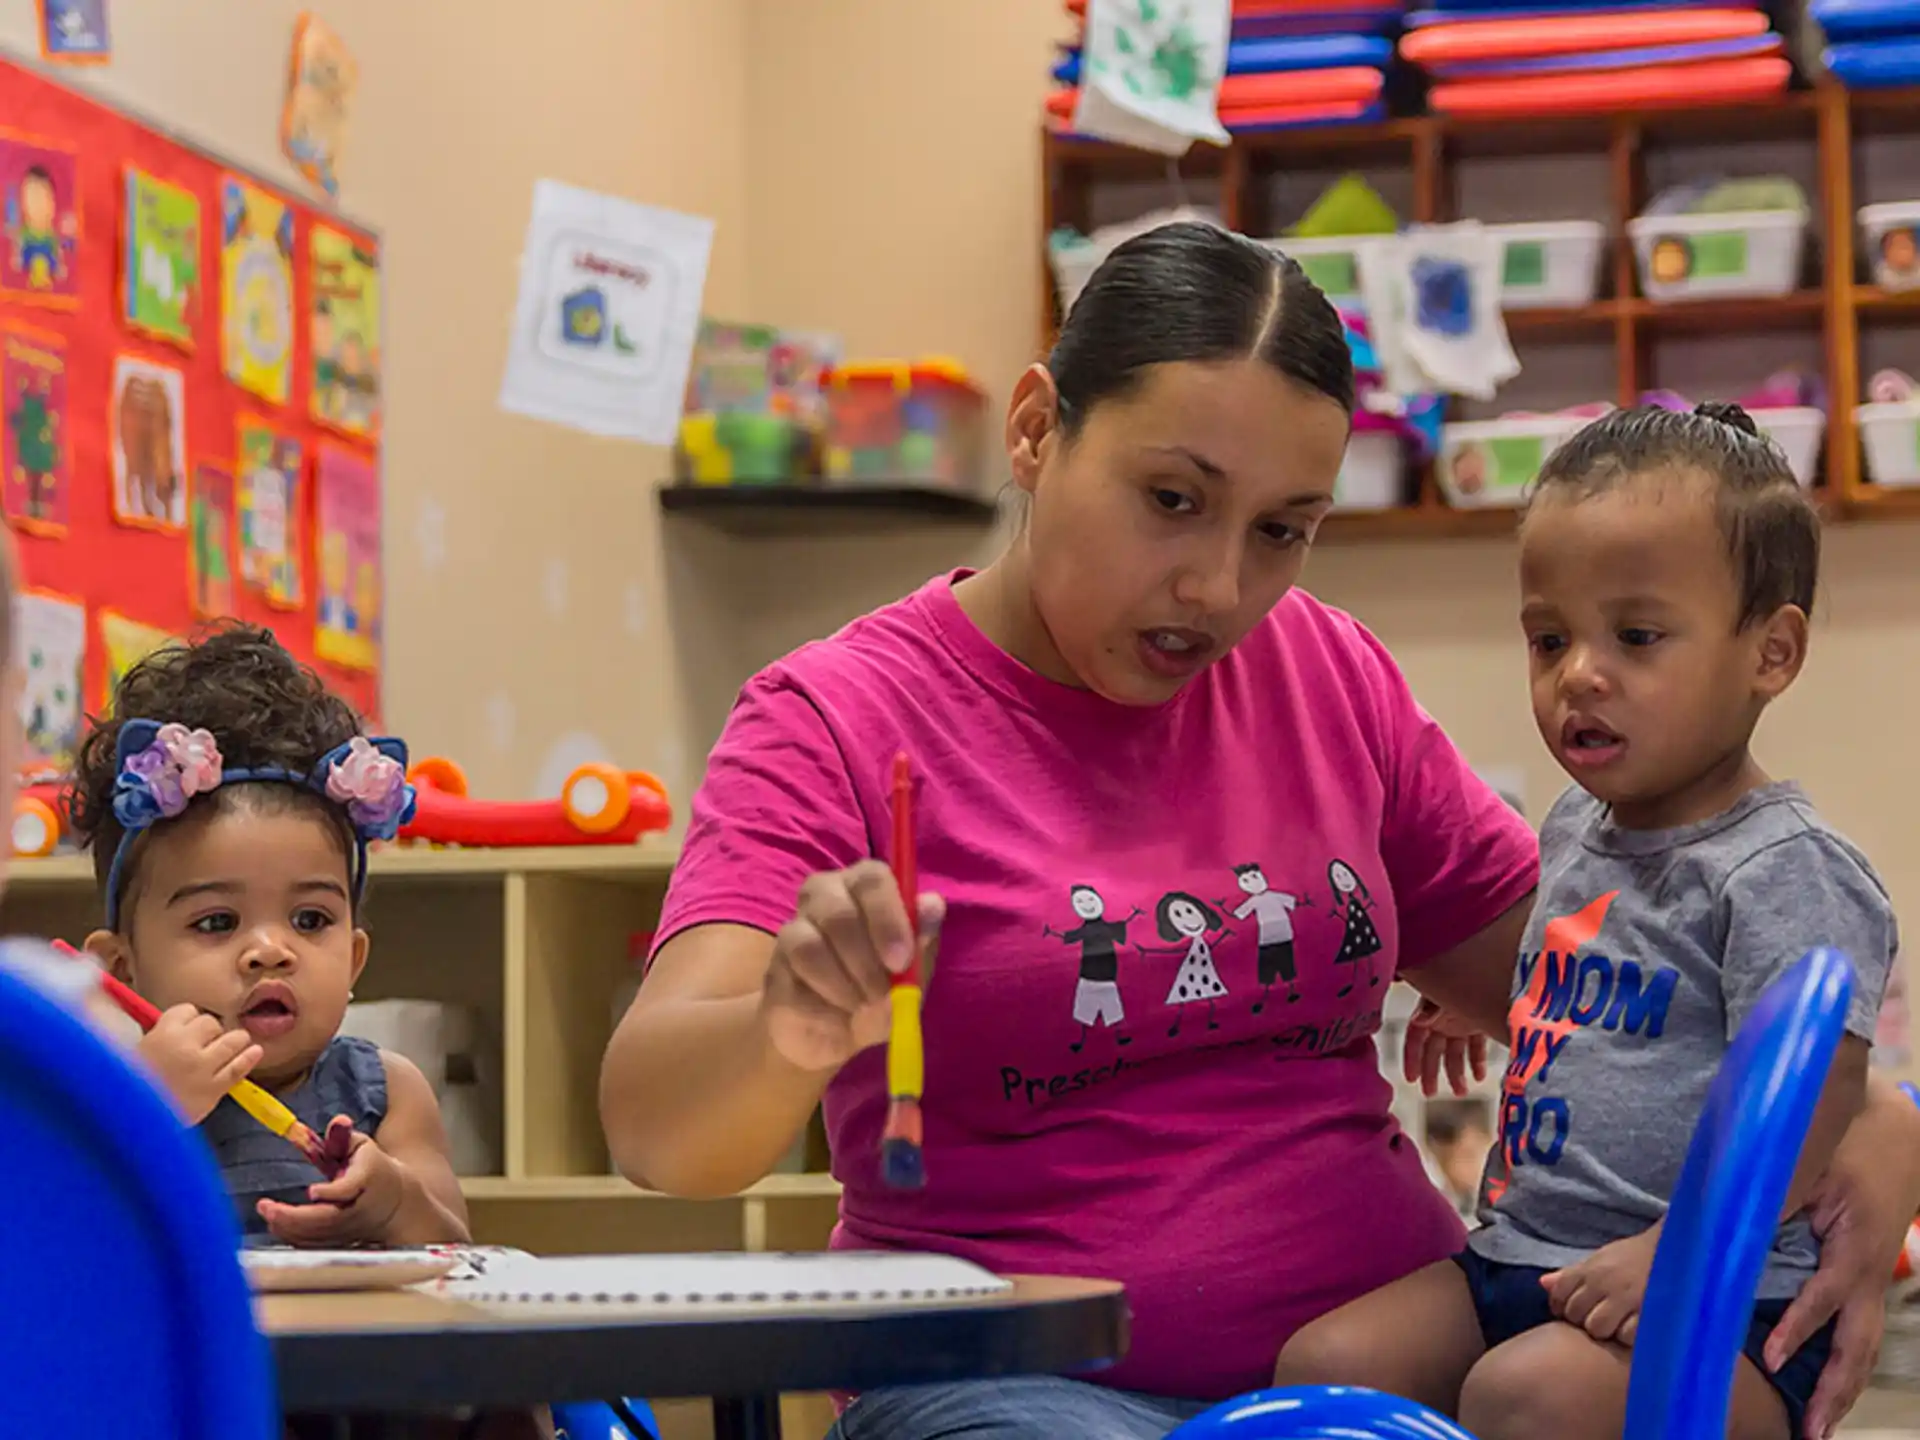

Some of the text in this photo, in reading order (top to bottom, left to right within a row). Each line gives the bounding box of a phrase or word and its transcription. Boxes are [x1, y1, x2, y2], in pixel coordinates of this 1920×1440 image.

[1530, 950, 1681, 1039] MOM
[1507, 1026, 1572, 1083] MY
[1501, 1094, 1570, 1167] RO
